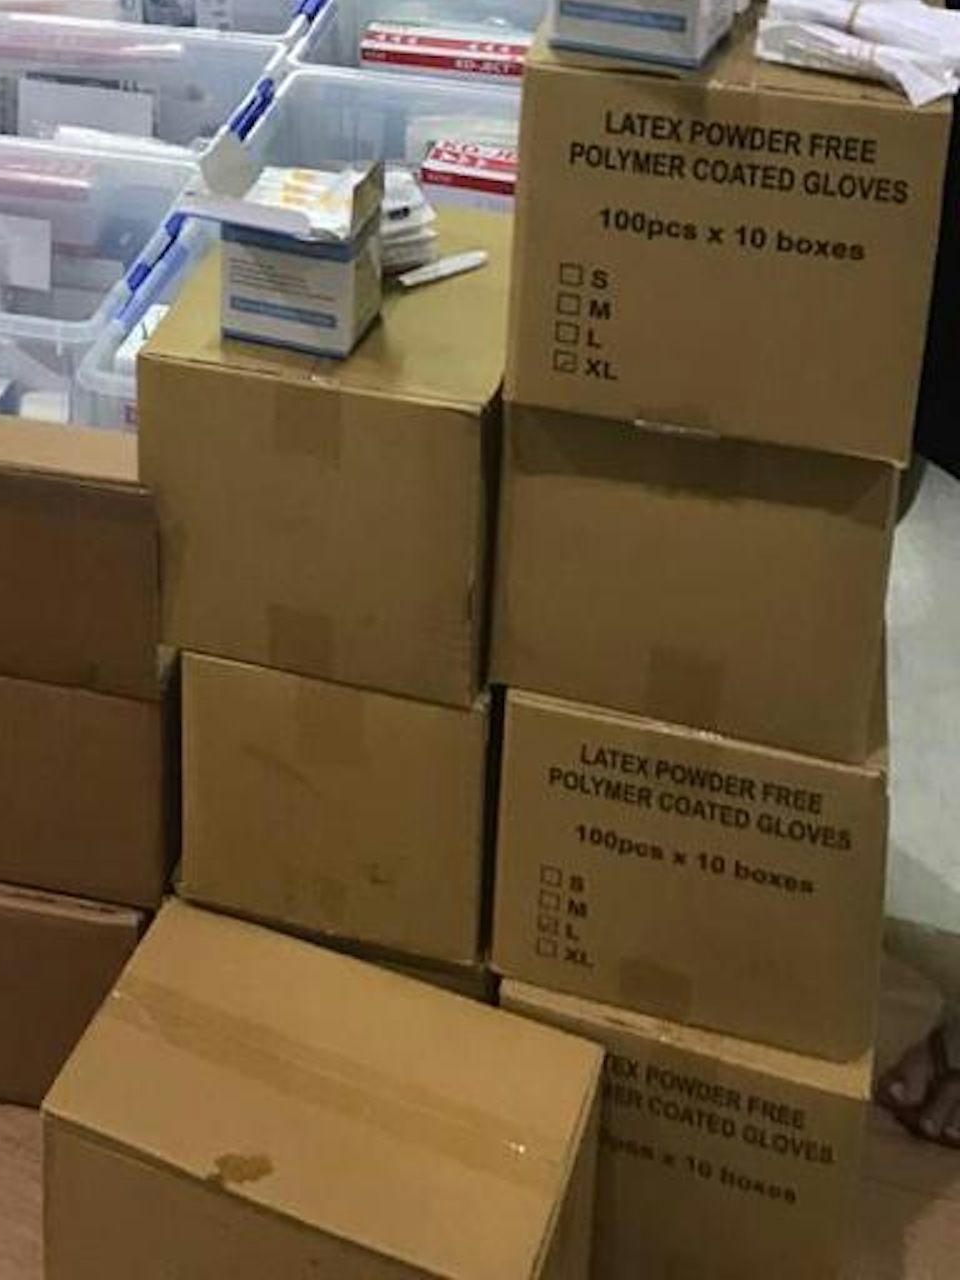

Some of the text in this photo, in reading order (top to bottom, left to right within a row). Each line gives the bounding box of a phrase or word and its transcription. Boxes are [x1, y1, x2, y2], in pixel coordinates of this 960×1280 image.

[605, 110, 877, 163] LATEX POWDER FREE
[569, 142, 908, 205] POLYMER COATED GLOVES
[599, 208, 866, 261] 100pcs x 10 boxes
[590, 269, 609, 289] S
[588, 299, 611, 320] M
[587, 327, 602, 348] L
[584, 356, 618, 380] XL
[580, 743, 823, 815] LATEX POWDER FREE
[548, 766, 852, 851] POLYMER COATED GLOVES
[575, 824, 814, 894] 100pcs x 10 boxes
[568, 874, 585, 893] S
[567, 899, 588, 918] M
[565, 923, 580, 941] L
[563, 946, 594, 968] XL
[646, 1065, 741, 1112] POWDER
[747, 1095, 805, 1130] FREE
[648, 1095, 736, 1138] COATED
[743, 1125, 834, 1164] GLOVES
